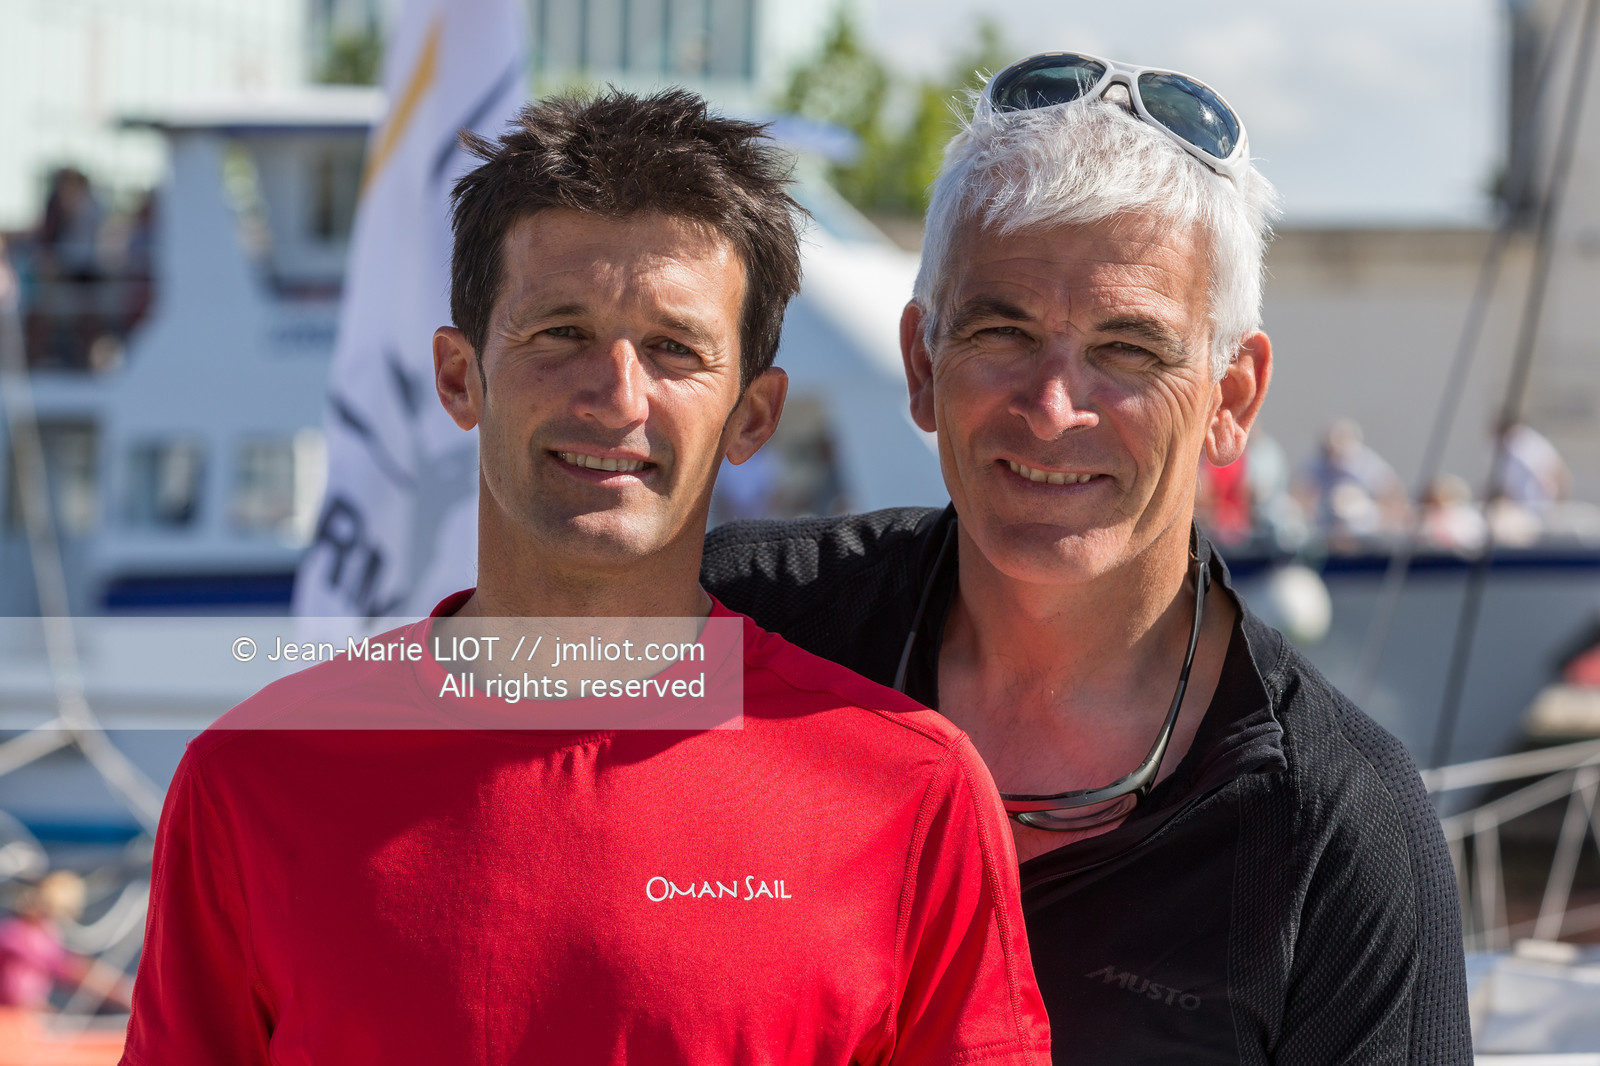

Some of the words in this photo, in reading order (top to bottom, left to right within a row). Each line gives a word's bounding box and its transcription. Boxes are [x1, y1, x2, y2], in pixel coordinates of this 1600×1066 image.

[646, 876, 738, 902] OMAN
[743, 875, 792, 901] SAIL
[1083, 965, 1201, 1011] MUSTO
